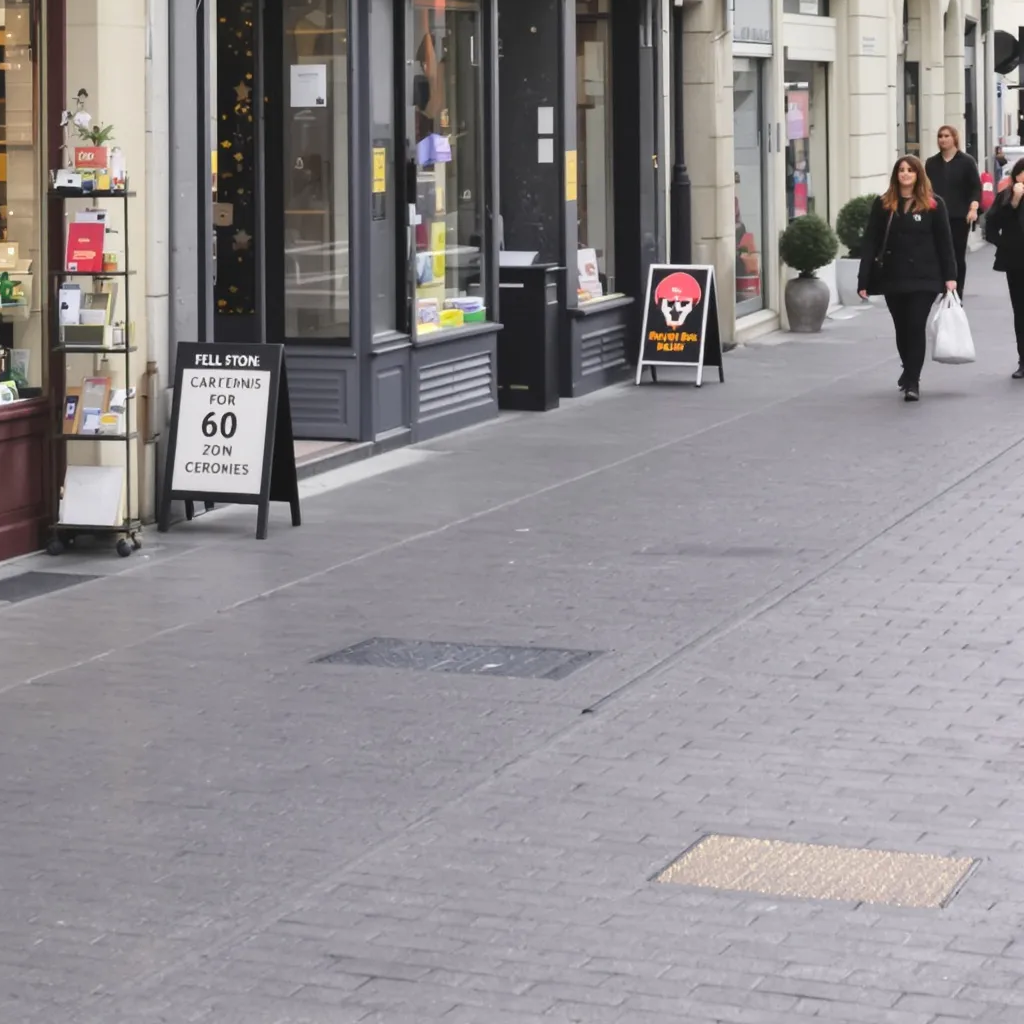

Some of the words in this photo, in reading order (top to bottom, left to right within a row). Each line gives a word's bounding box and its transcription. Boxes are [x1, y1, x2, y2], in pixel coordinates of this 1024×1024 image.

[195, 354, 222, 366] FELL
[209, 394, 236, 406] FOR
[201, 411, 238, 439] 60
[202, 444, 233, 456] ZON
